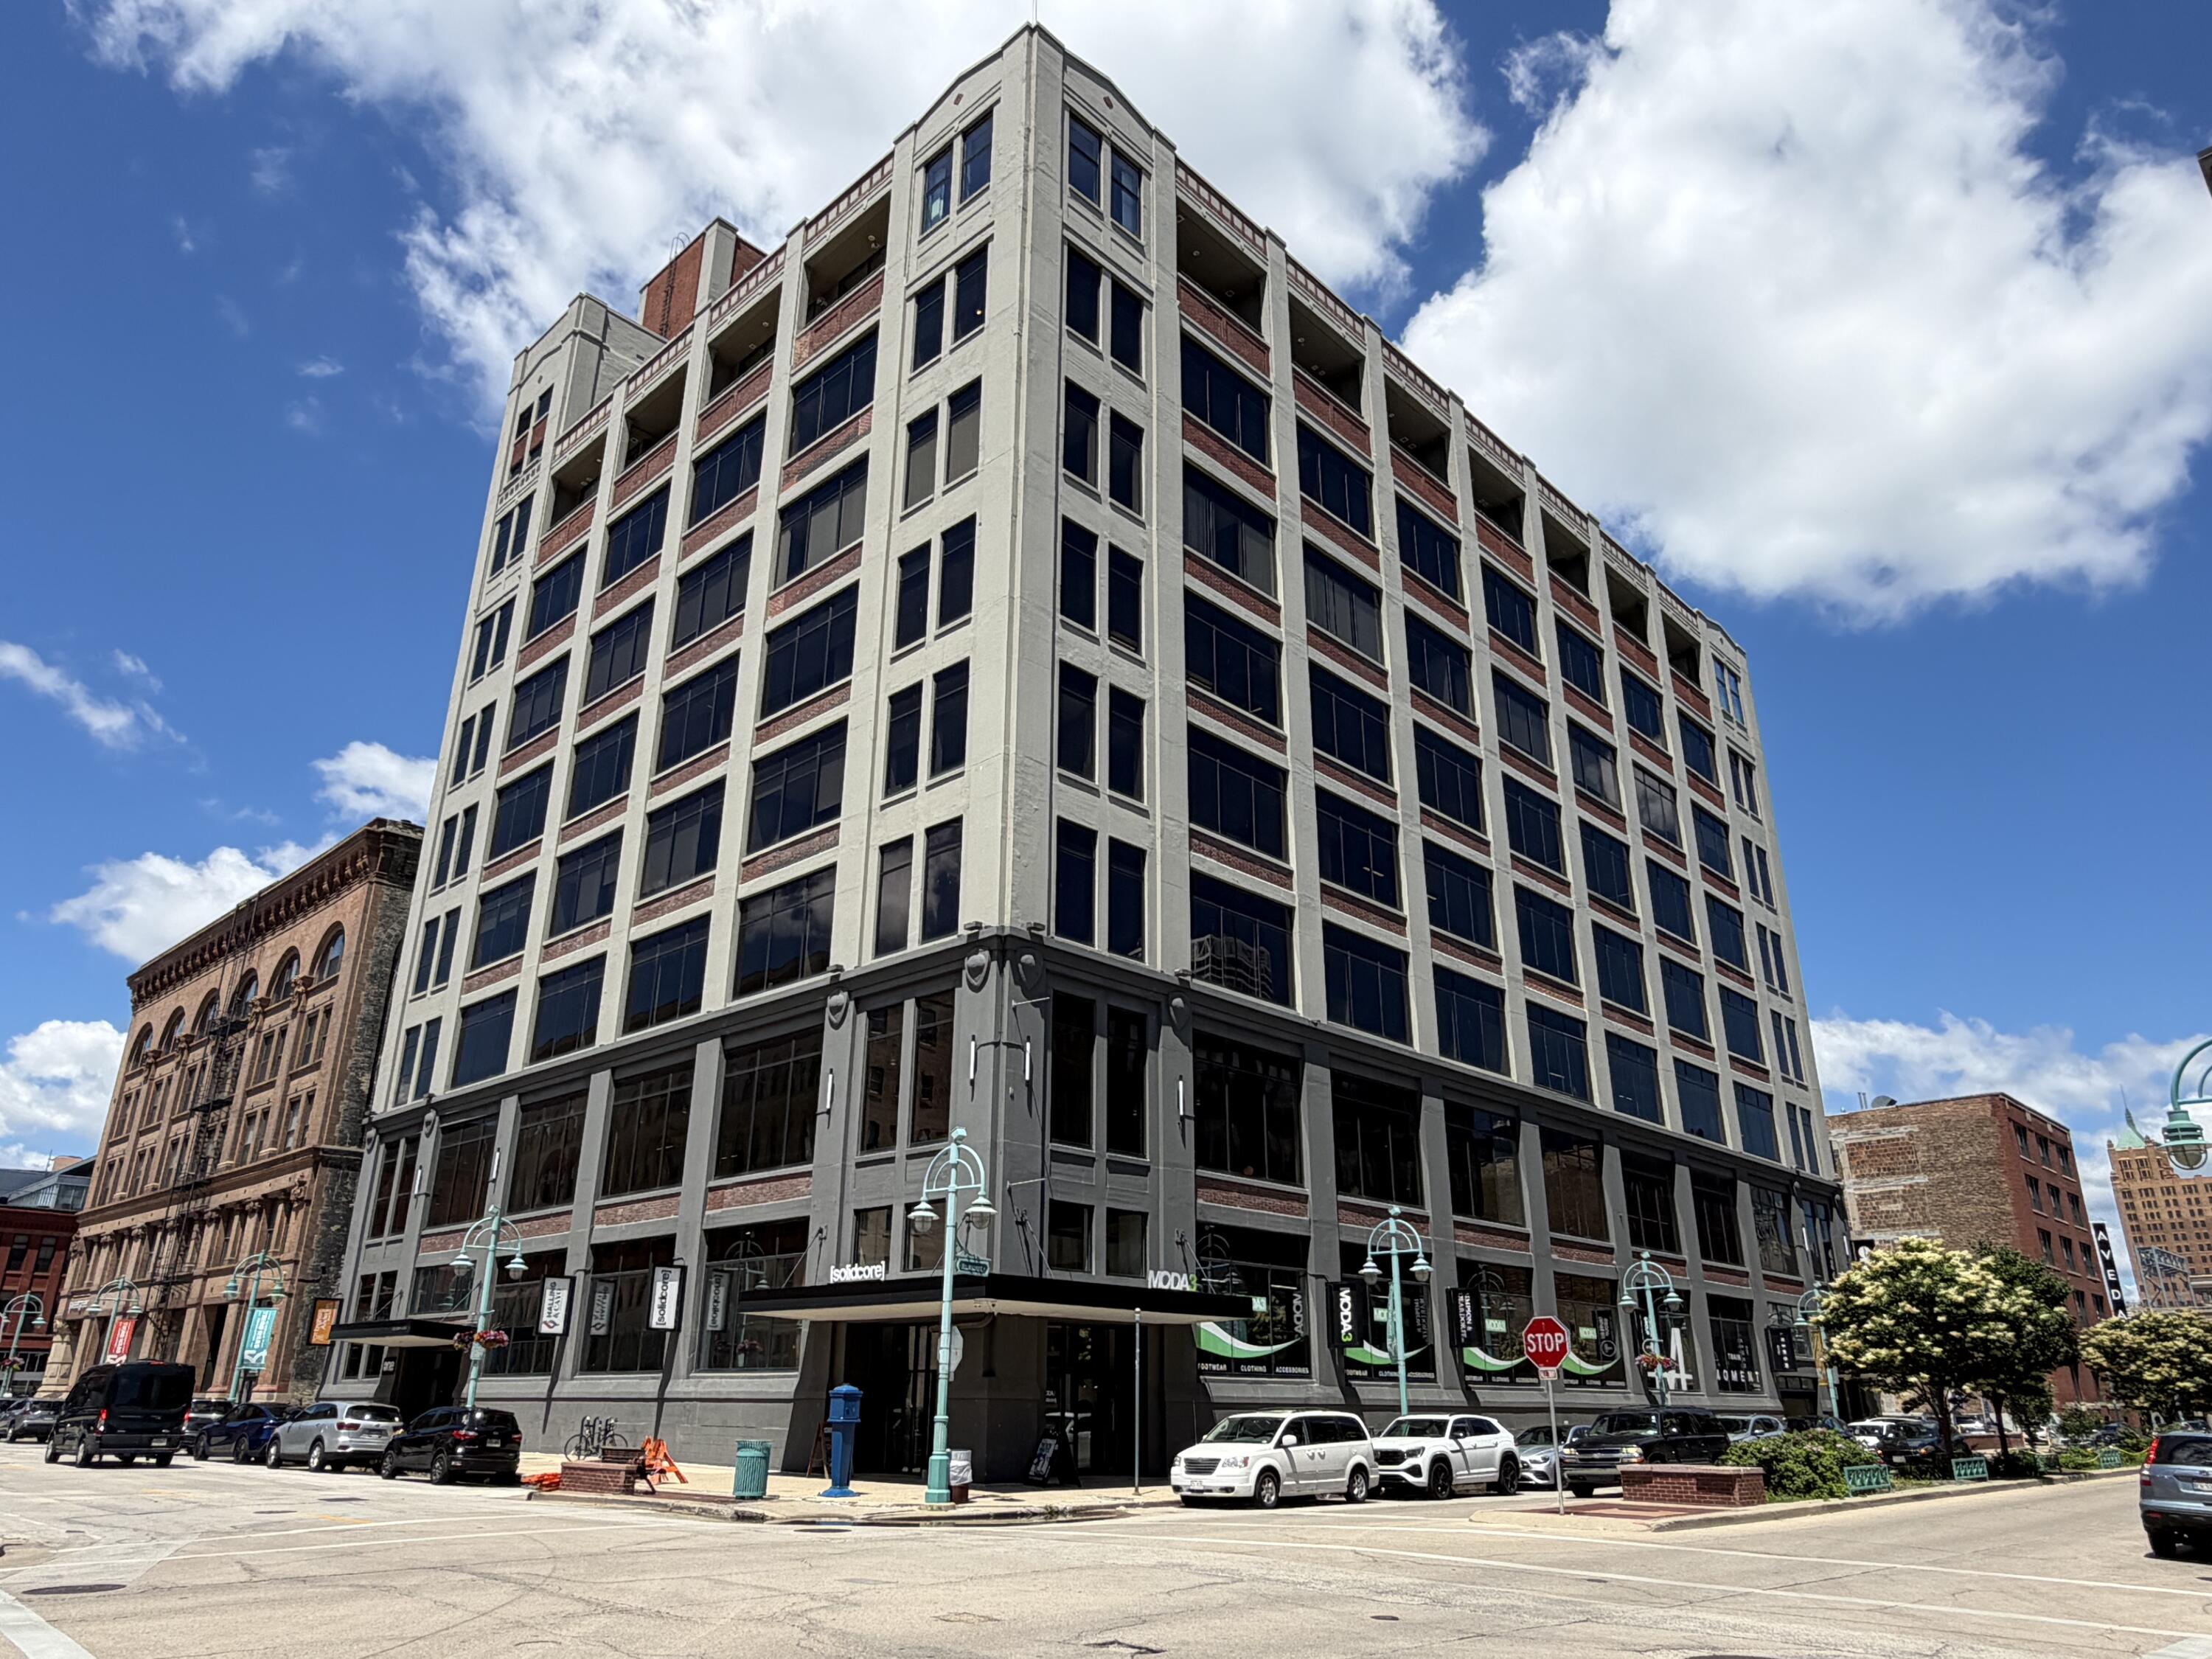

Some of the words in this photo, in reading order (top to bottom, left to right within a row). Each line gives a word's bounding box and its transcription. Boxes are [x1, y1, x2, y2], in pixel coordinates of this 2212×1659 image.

[830, 1260, 885, 1284] [solidcore]
[1148, 1270, 1197, 1291] MODA3
[2097, 1230, 2128, 1319] AVEDA
[546, 1281, 556, 1318] HALLING
[655, 1270, 672, 1326] [solidcore]
[1339, 1287, 1352, 1342] MODA3
[1526, 1332, 1564, 1353] STOP
[1197, 1363, 1227, 1371] FOOTWEAR
[1240, 1365, 1267, 1373] CLOTHING
